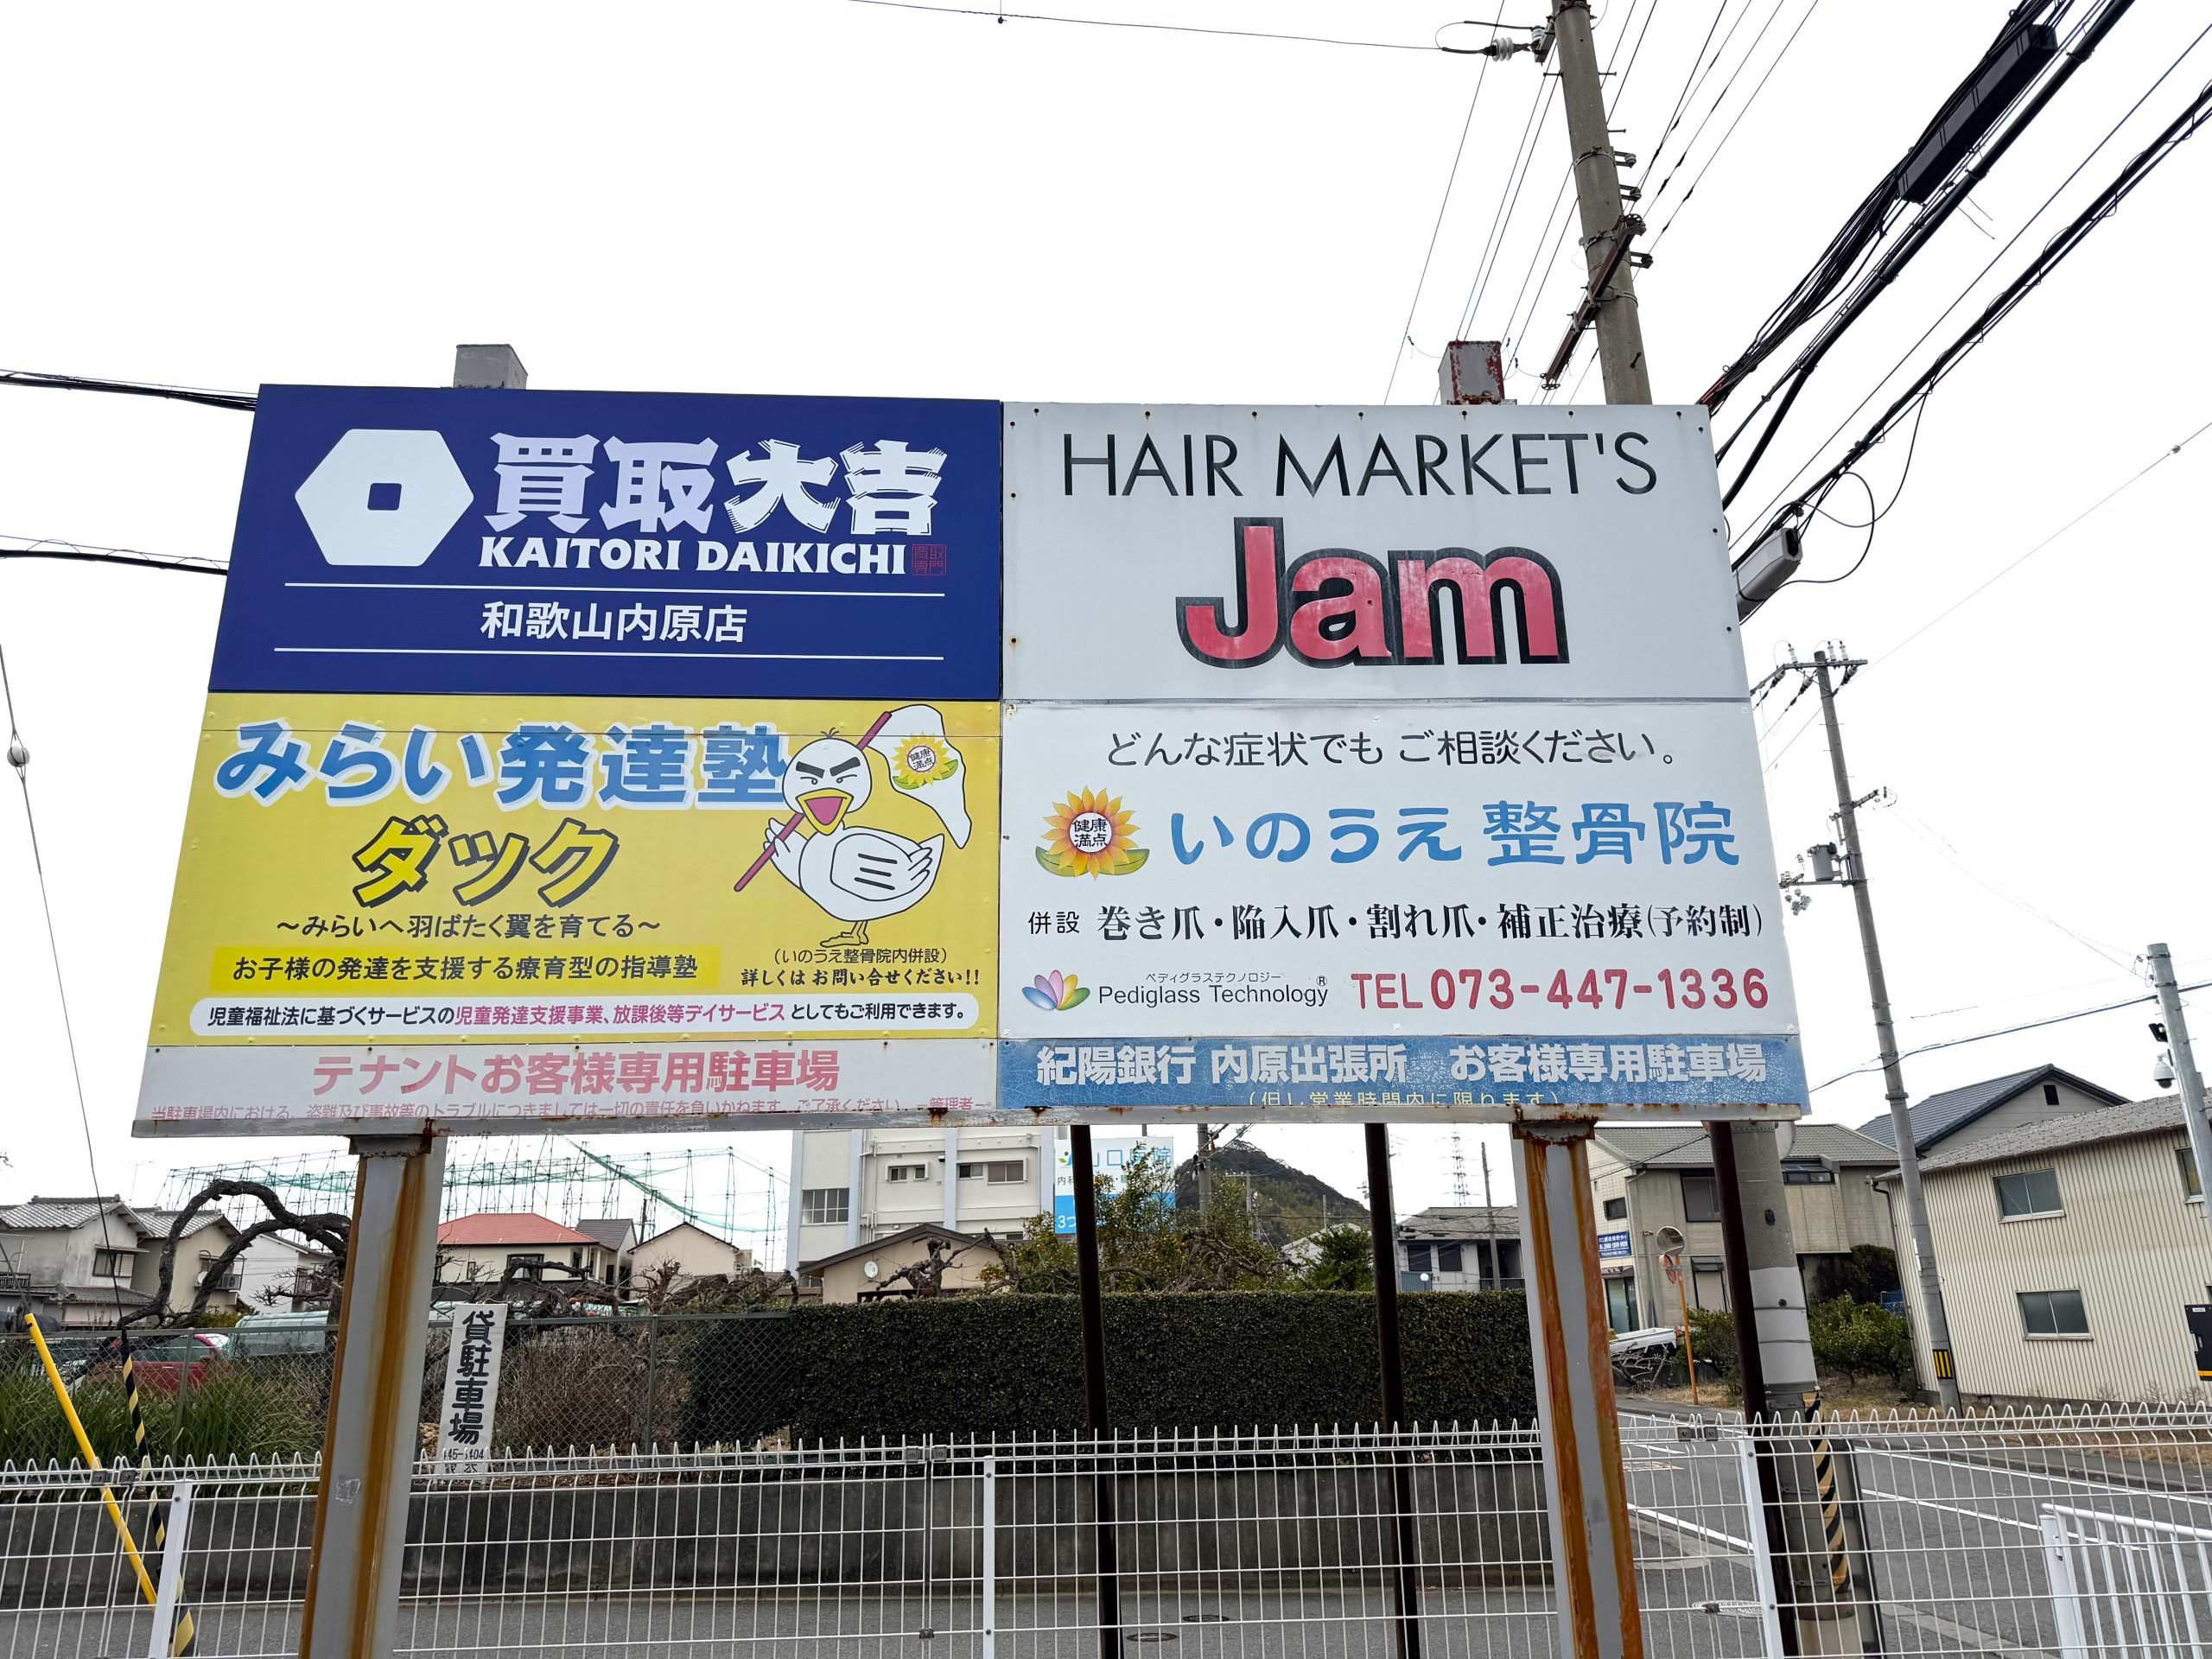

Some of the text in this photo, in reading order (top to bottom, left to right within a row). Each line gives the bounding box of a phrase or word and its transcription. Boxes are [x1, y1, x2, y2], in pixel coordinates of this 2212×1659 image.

[485, 432, 948, 536] 買取大吉
[1063, 431, 1657, 498] HAIR MARKET'S
[479, 537, 906, 575] KAITORI DAIKICHI
[1176, 517, 1570, 670] Jam
[480, 601, 749, 643] 和歌山内原店
[214, 720, 789, 811] みらい発達塾
[1107, 729, 1673, 767] どんな症状でも ご相談ください。
[1072, 817, 1108, 832] 健康
[1073, 833, 1108, 848] 満点
[352, 814, 620, 908] ダック
[1028, 911, 1080, 935] 併設
[232, 954, 698, 982] お子様の発達を支援する療育型の指導塾
[774, 948, 947, 963] (いのうえ整骨院内併設)
[1099, 986, 1200, 1007] Pediglass
[1209, 983, 1328, 1007] Technology
[1351, 968, 1769, 1010] TEL 073-447-1336
[313, 1049, 840, 1096] テナントお客様専用駐車場
[1037, 1042, 1767, 1086] 紀陽銀行 内原出張所 お客様専用駐車場
[448, 1310, 495, 1446] 貸駐車場
